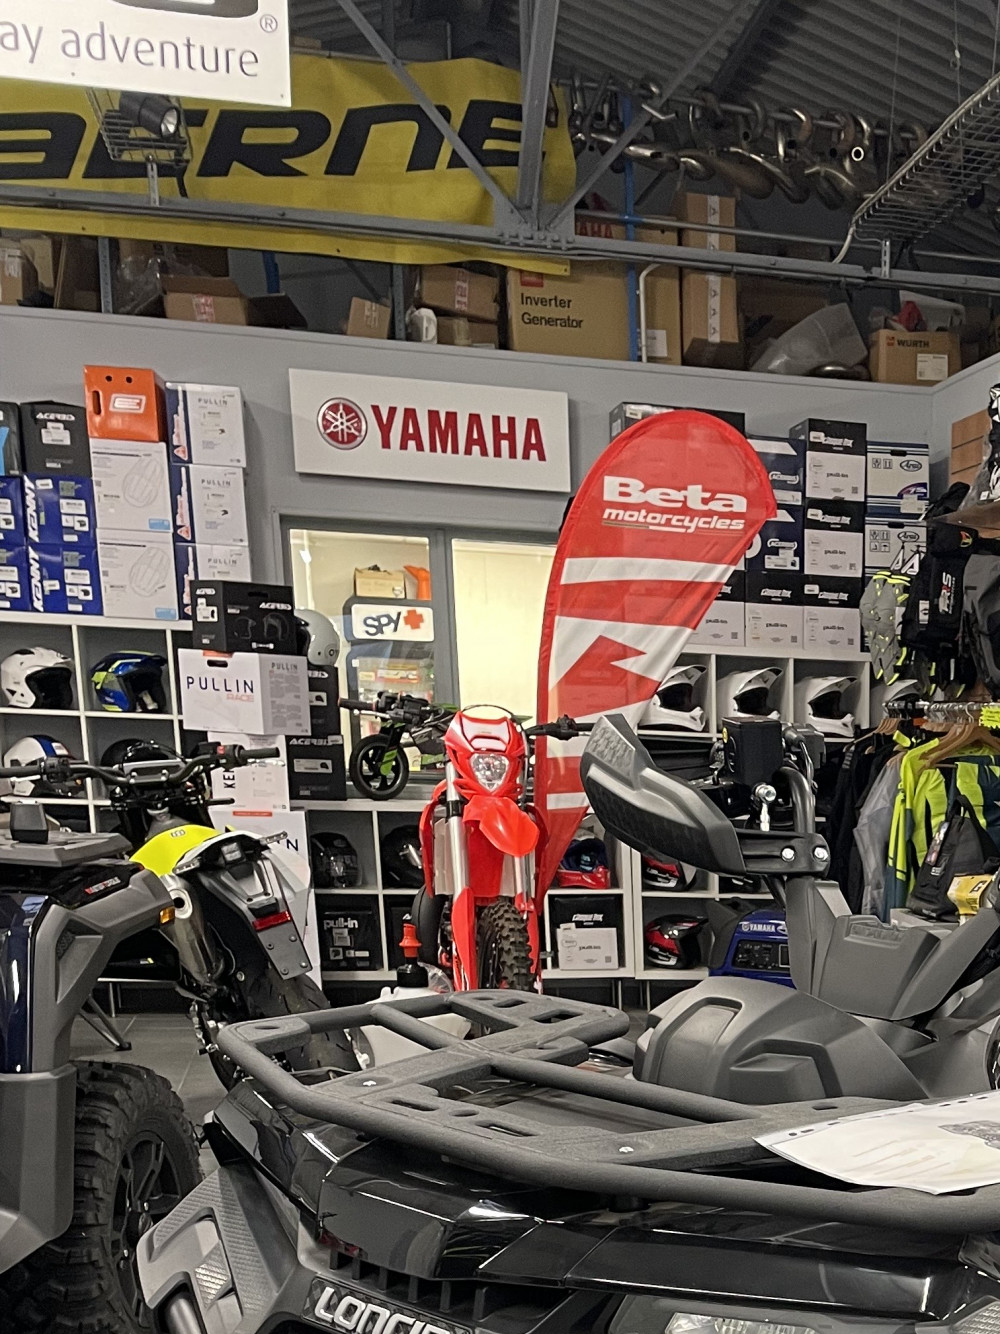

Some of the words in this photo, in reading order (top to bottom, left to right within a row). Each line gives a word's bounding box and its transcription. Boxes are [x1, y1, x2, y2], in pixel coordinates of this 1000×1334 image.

[61, 21, 259, 78] adventure
[520, 292, 573, 309] Inverter
[520, 311, 584, 330] Generator
[370, 404, 547, 462] YAMAHA
[603, 475, 748, 513] Beta
[603, 508, 745, 534] motorcycles
[362, 611, 402, 637] SPY
[186, 675, 255, 694] PULLIN
[323, 917, 359, 931] pull-in
[749, 923, 776, 933] YAMAHA
